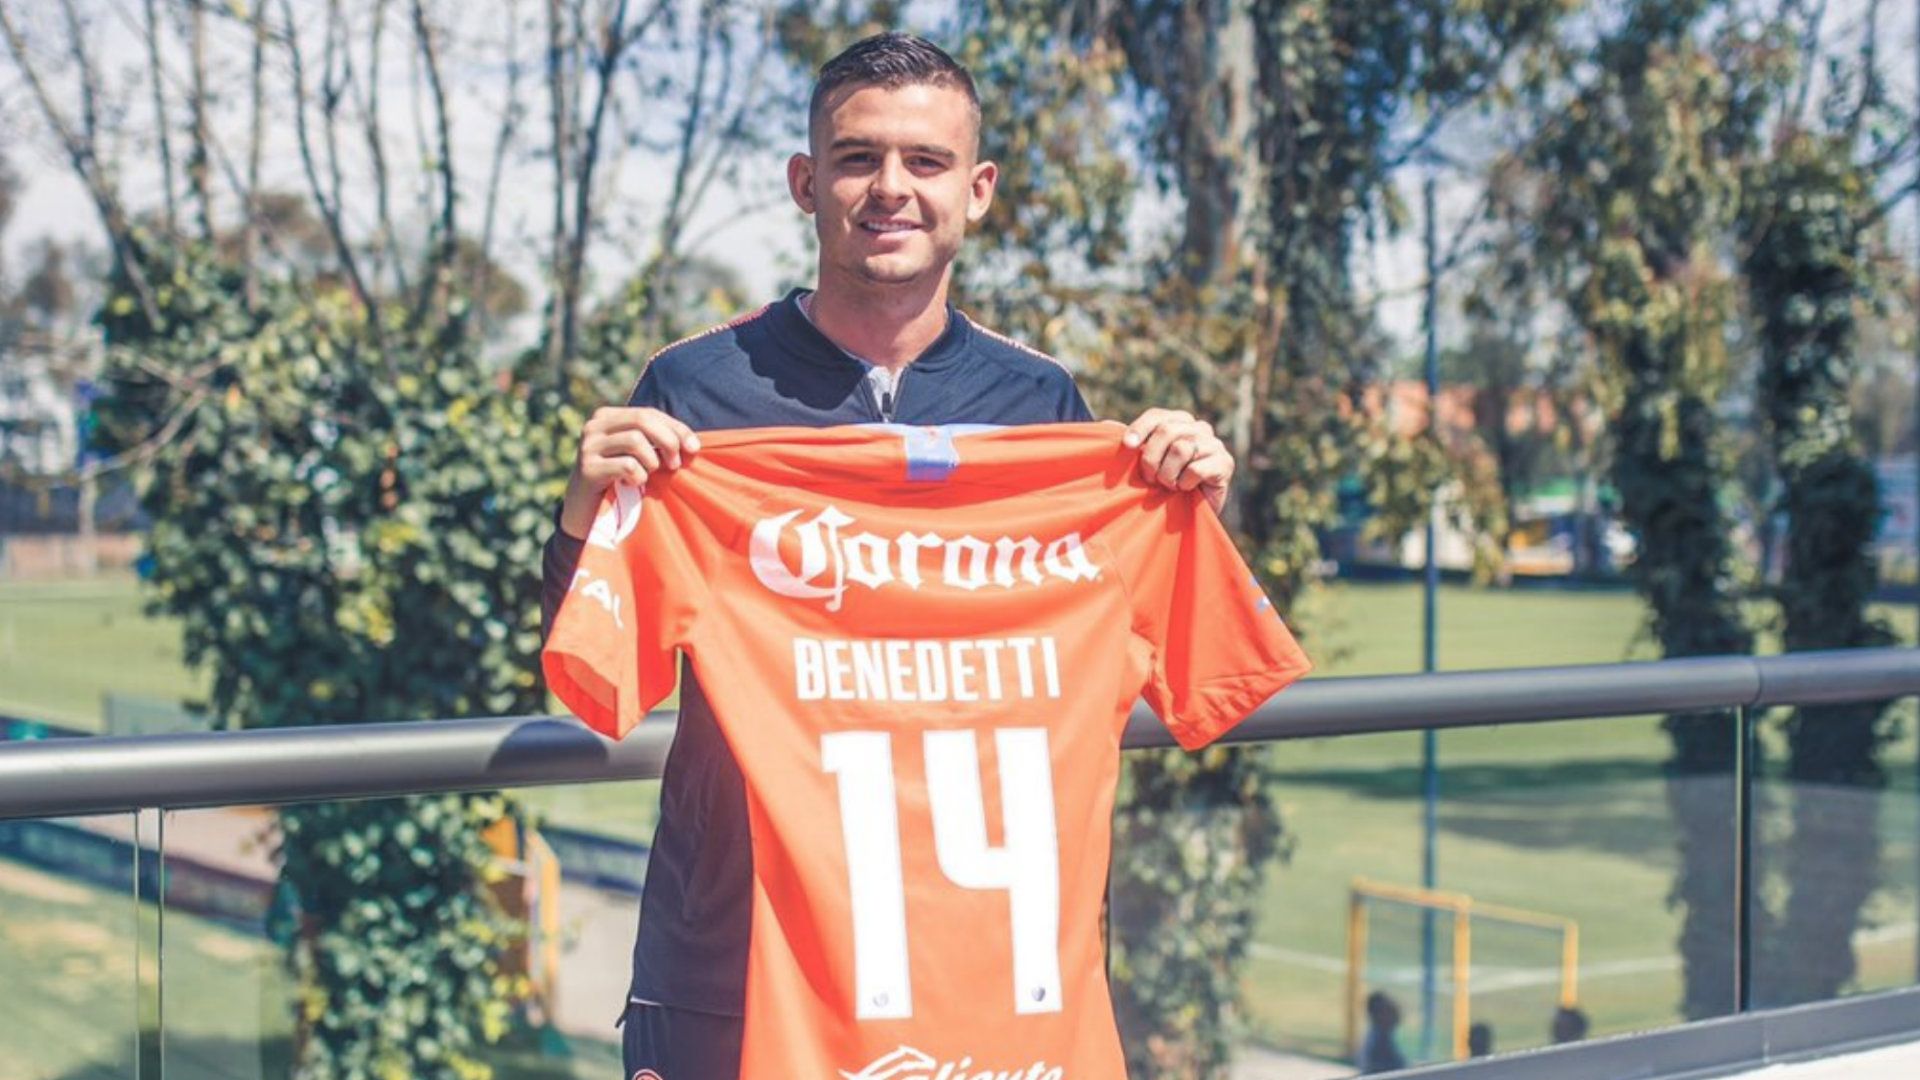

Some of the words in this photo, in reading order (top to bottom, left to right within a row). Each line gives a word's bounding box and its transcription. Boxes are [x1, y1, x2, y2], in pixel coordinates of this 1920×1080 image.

[749, 506, 1099, 611] Corona
[794, 637, 1060, 701] BENEDETTI
[821, 728, 1062, 1019] 14
[838, 1046, 1064, 1080] Clinte
